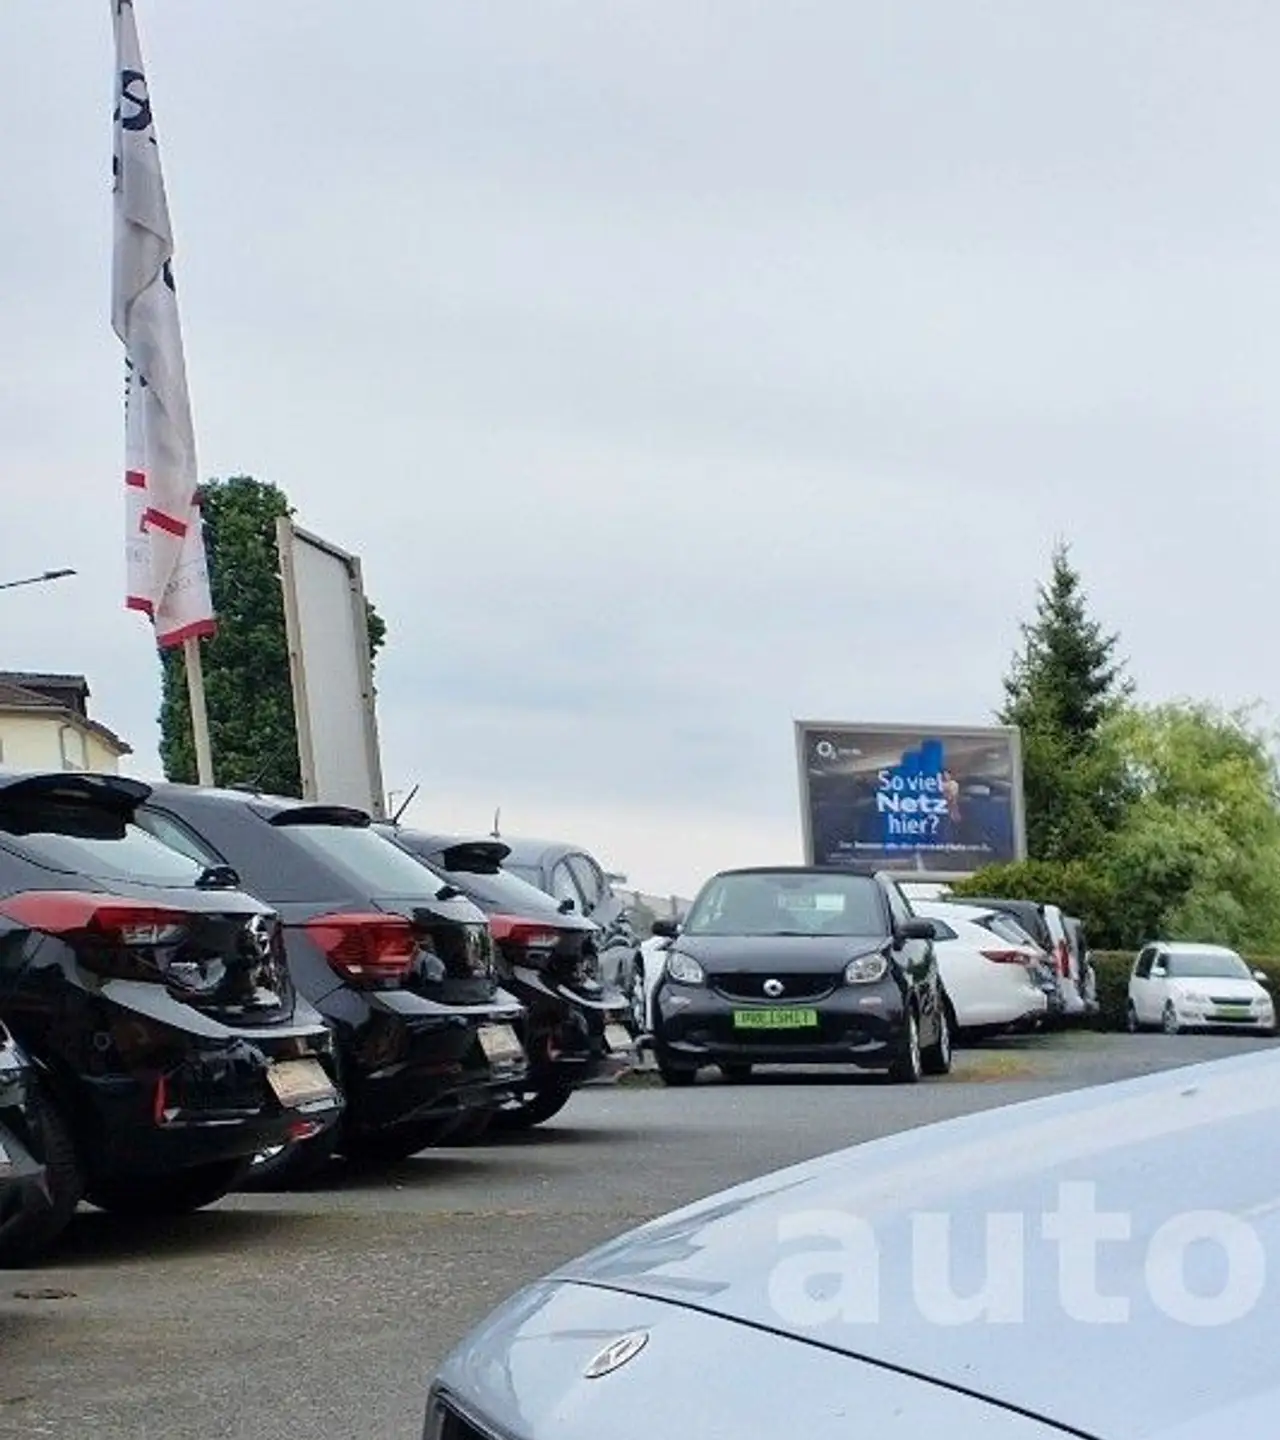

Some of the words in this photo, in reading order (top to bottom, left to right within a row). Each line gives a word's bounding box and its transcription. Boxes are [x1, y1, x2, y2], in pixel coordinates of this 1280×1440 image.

[878, 770, 904, 791] So
[906, 771, 945, 791] viel
[876, 792, 948, 813] Netz
[888, 814, 940, 834] hier?
